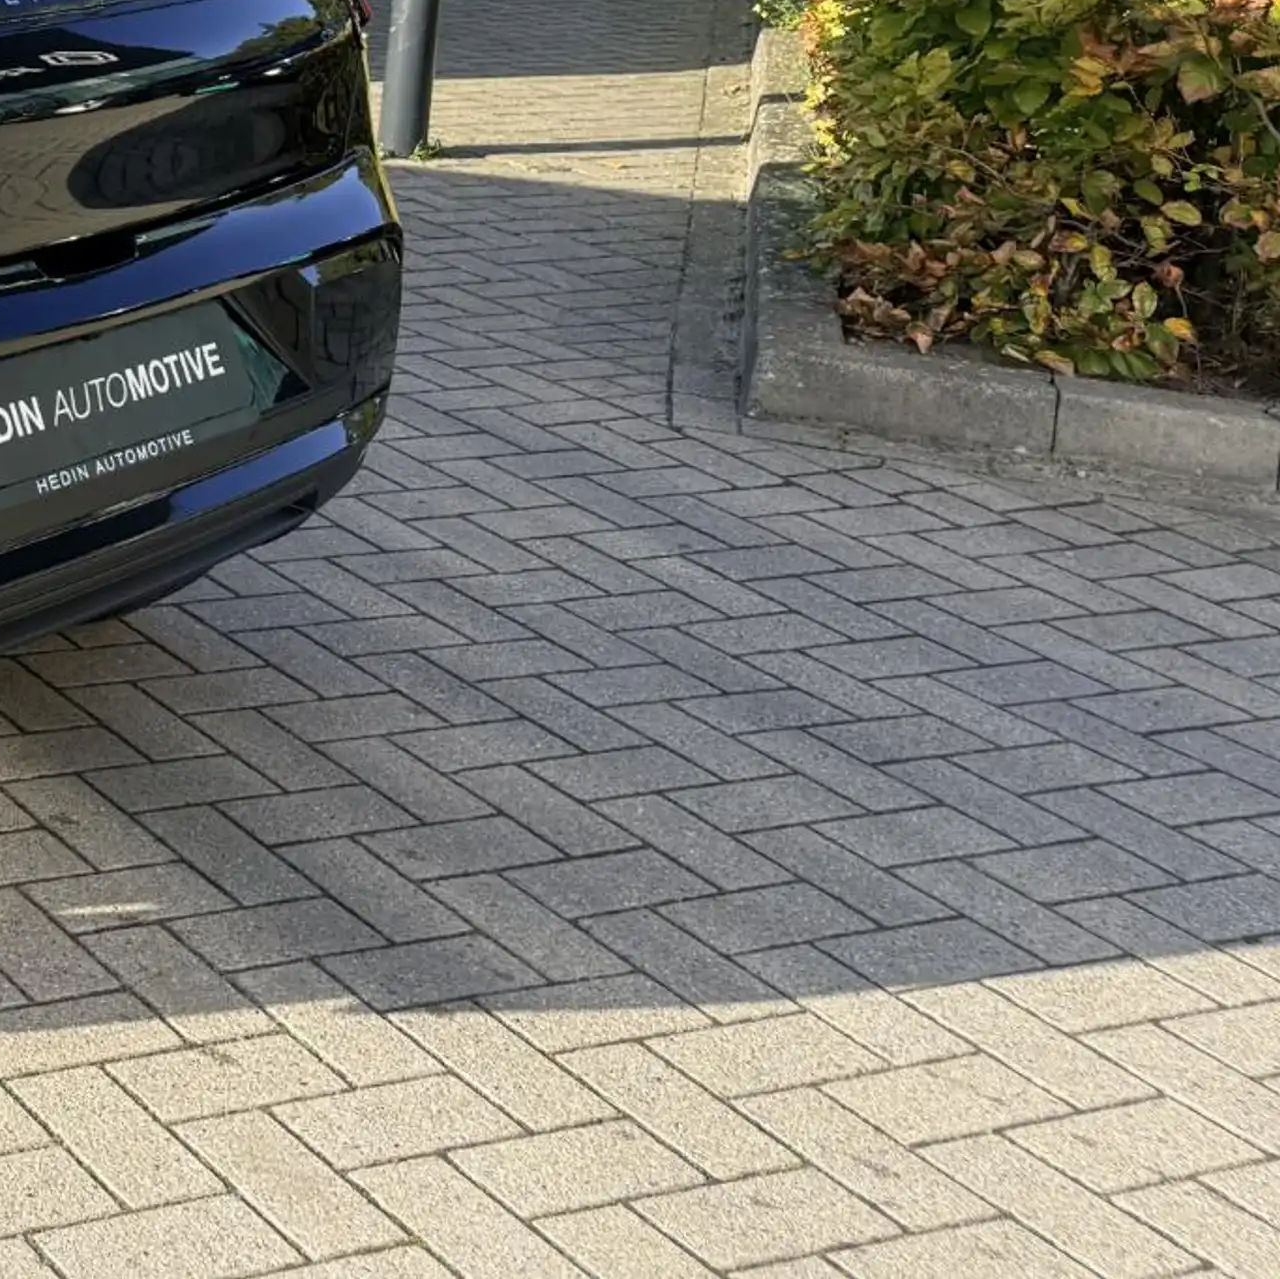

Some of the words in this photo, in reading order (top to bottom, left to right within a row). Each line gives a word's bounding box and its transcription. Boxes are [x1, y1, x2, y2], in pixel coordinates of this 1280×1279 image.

[53, 342, 225, 426] AUTOMOTIVE
[36, 467, 90, 495] HEDIN
[95, 429, 194, 476] AUTOMOTIVE
